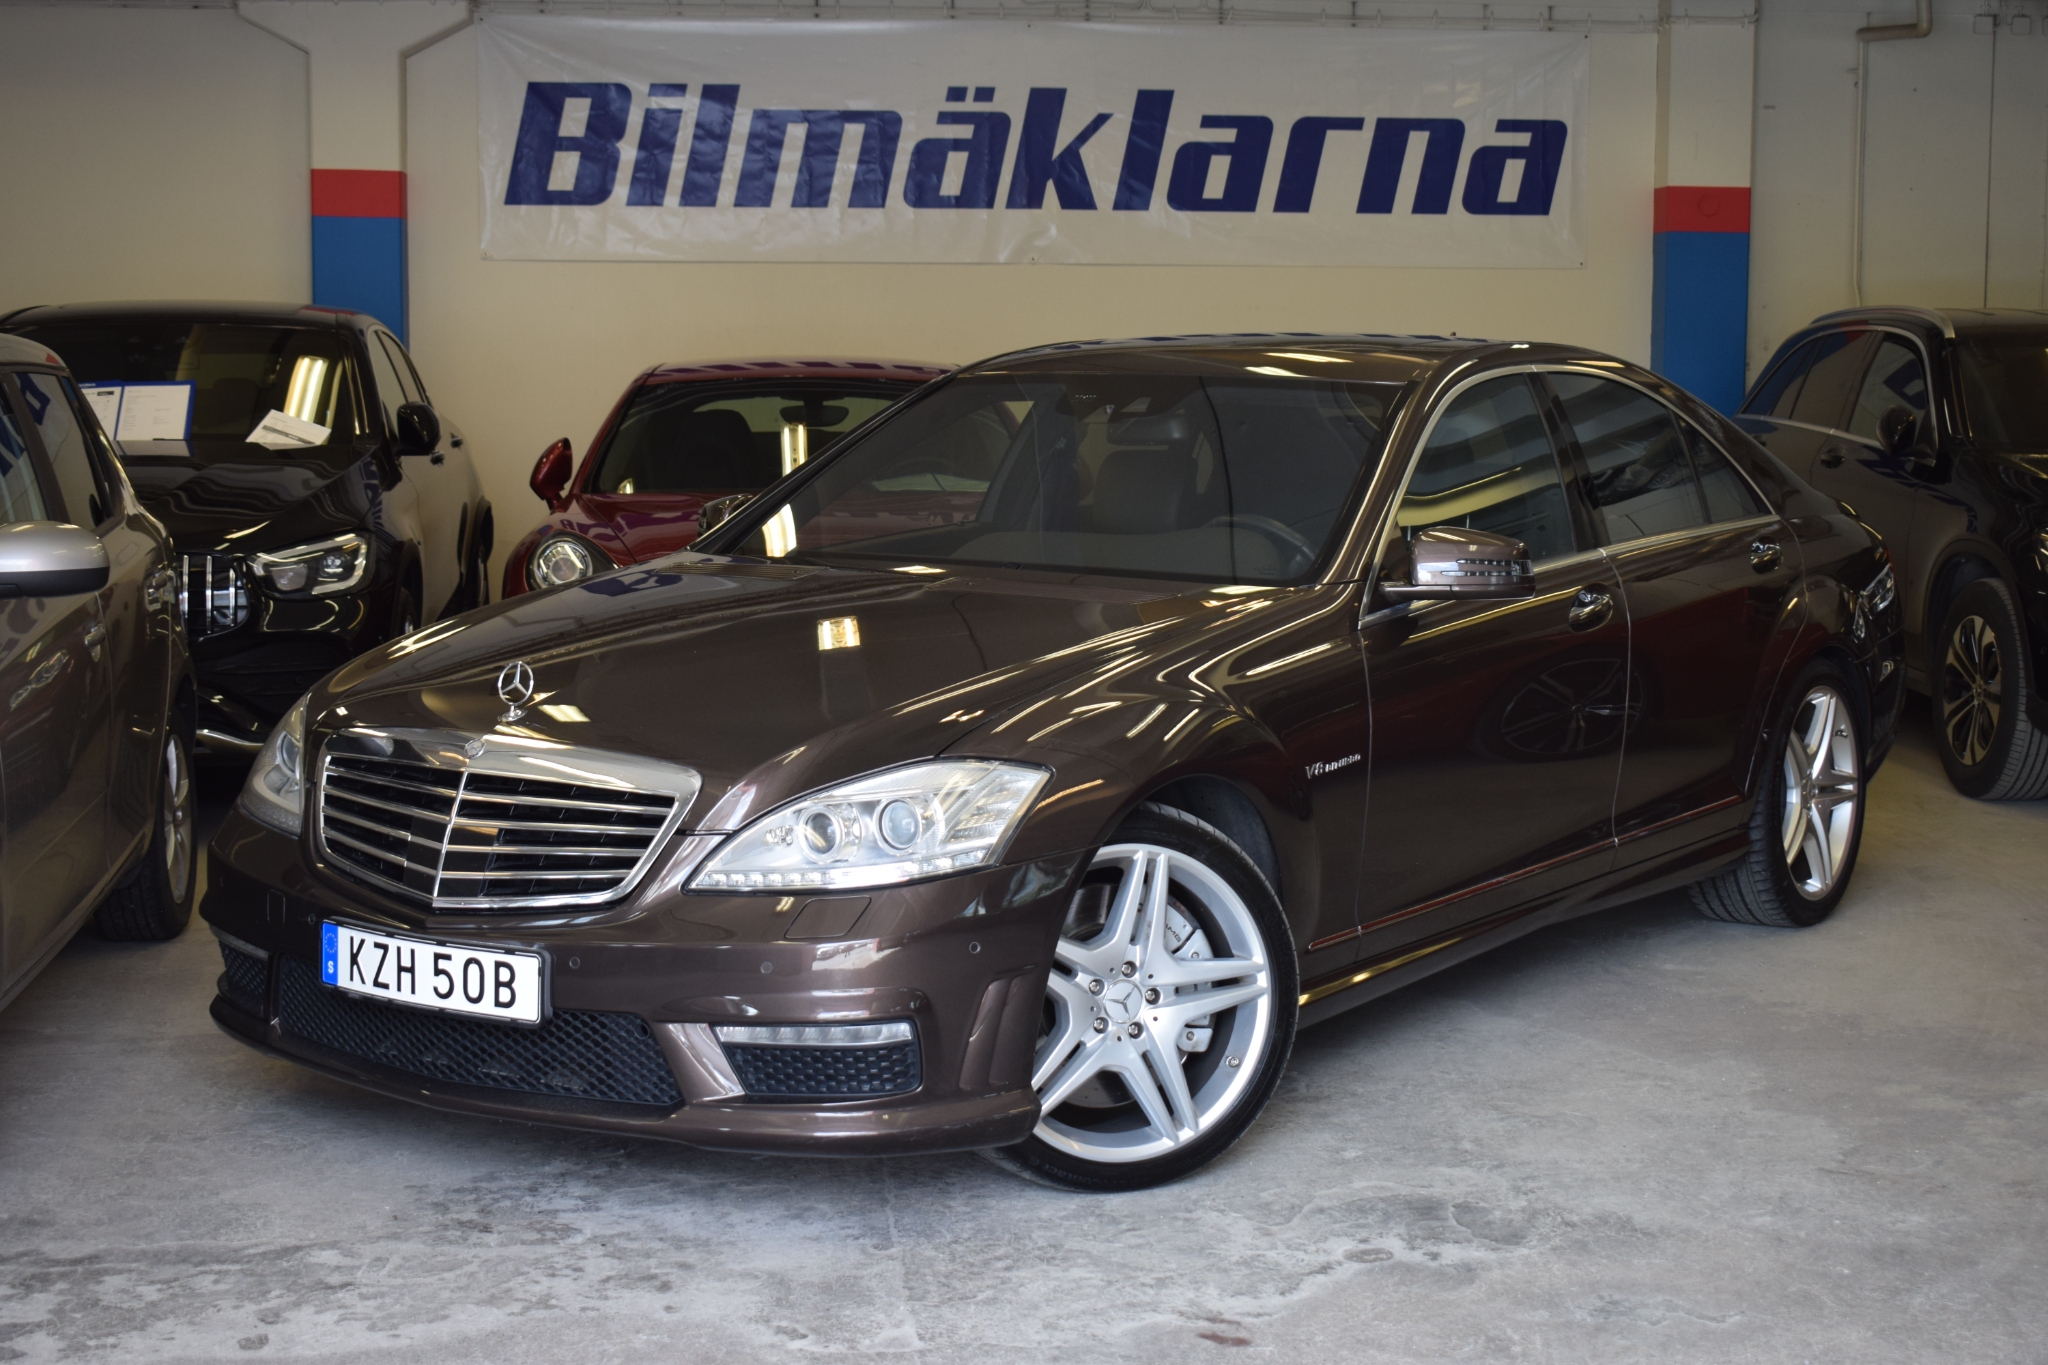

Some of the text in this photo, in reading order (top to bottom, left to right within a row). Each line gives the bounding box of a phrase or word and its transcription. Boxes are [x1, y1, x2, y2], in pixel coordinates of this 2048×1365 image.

[505, 82, 1567, 215] Bilmäklarna
[327, 961, 335, 974] S
[349, 935, 517, 1009] KZH 50B
